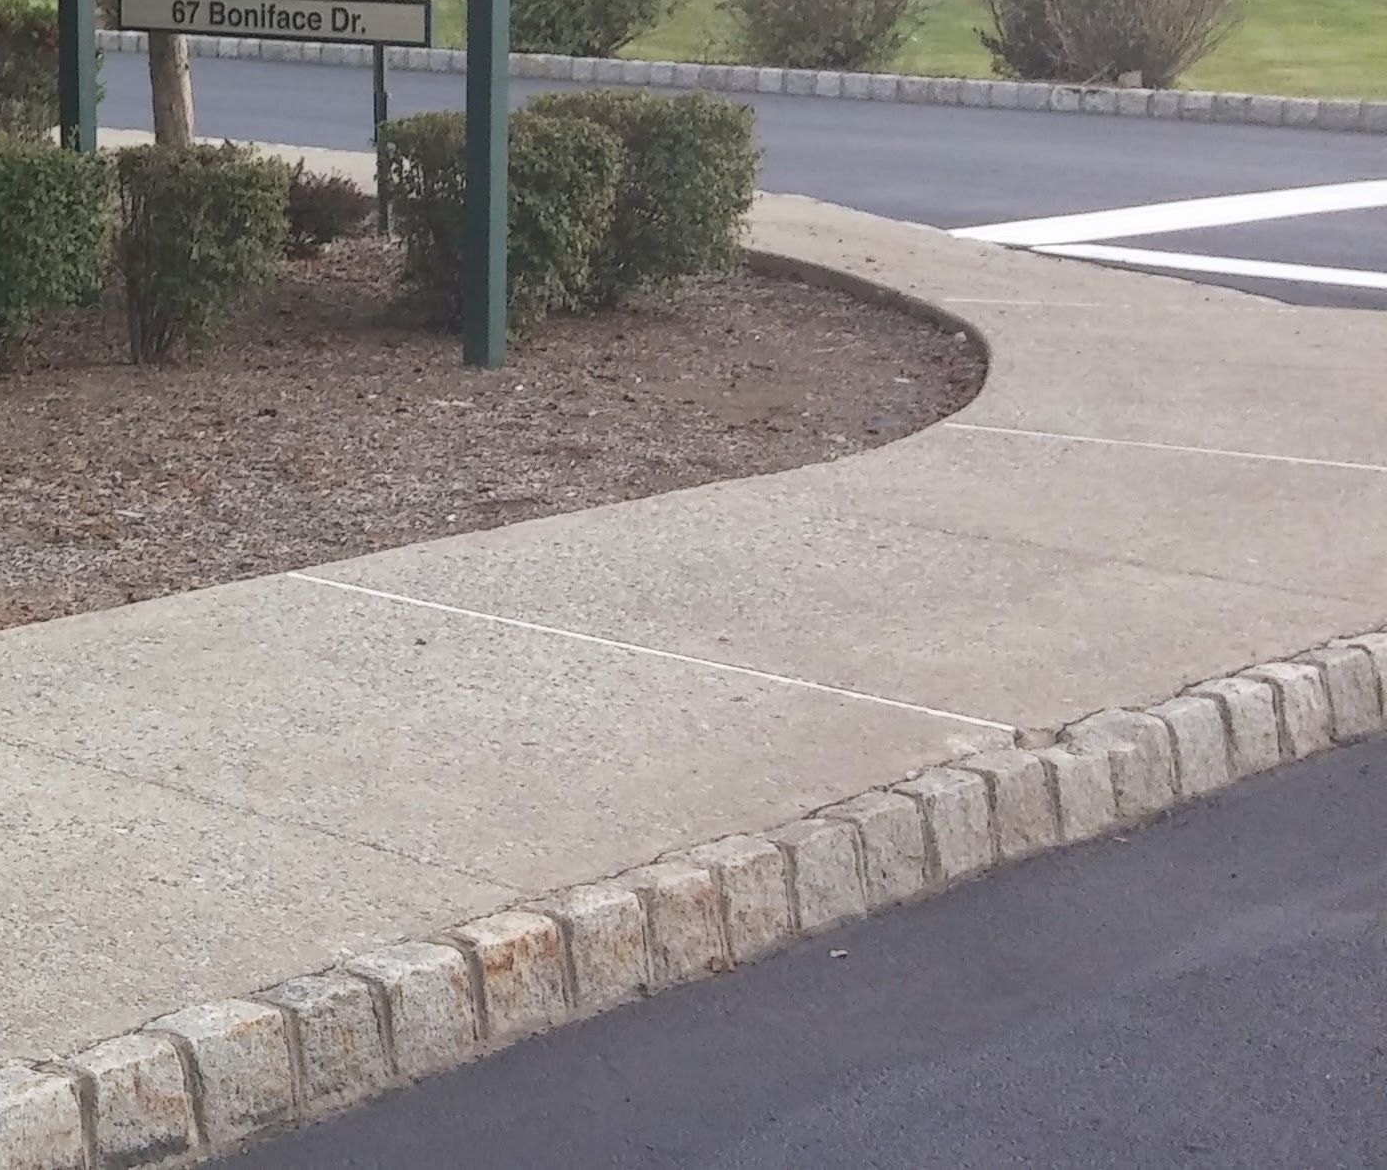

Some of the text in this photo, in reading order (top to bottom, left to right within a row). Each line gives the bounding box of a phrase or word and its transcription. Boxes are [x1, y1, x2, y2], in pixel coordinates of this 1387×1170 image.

[172, 0, 366, 33] 67 Boniface Dr.
